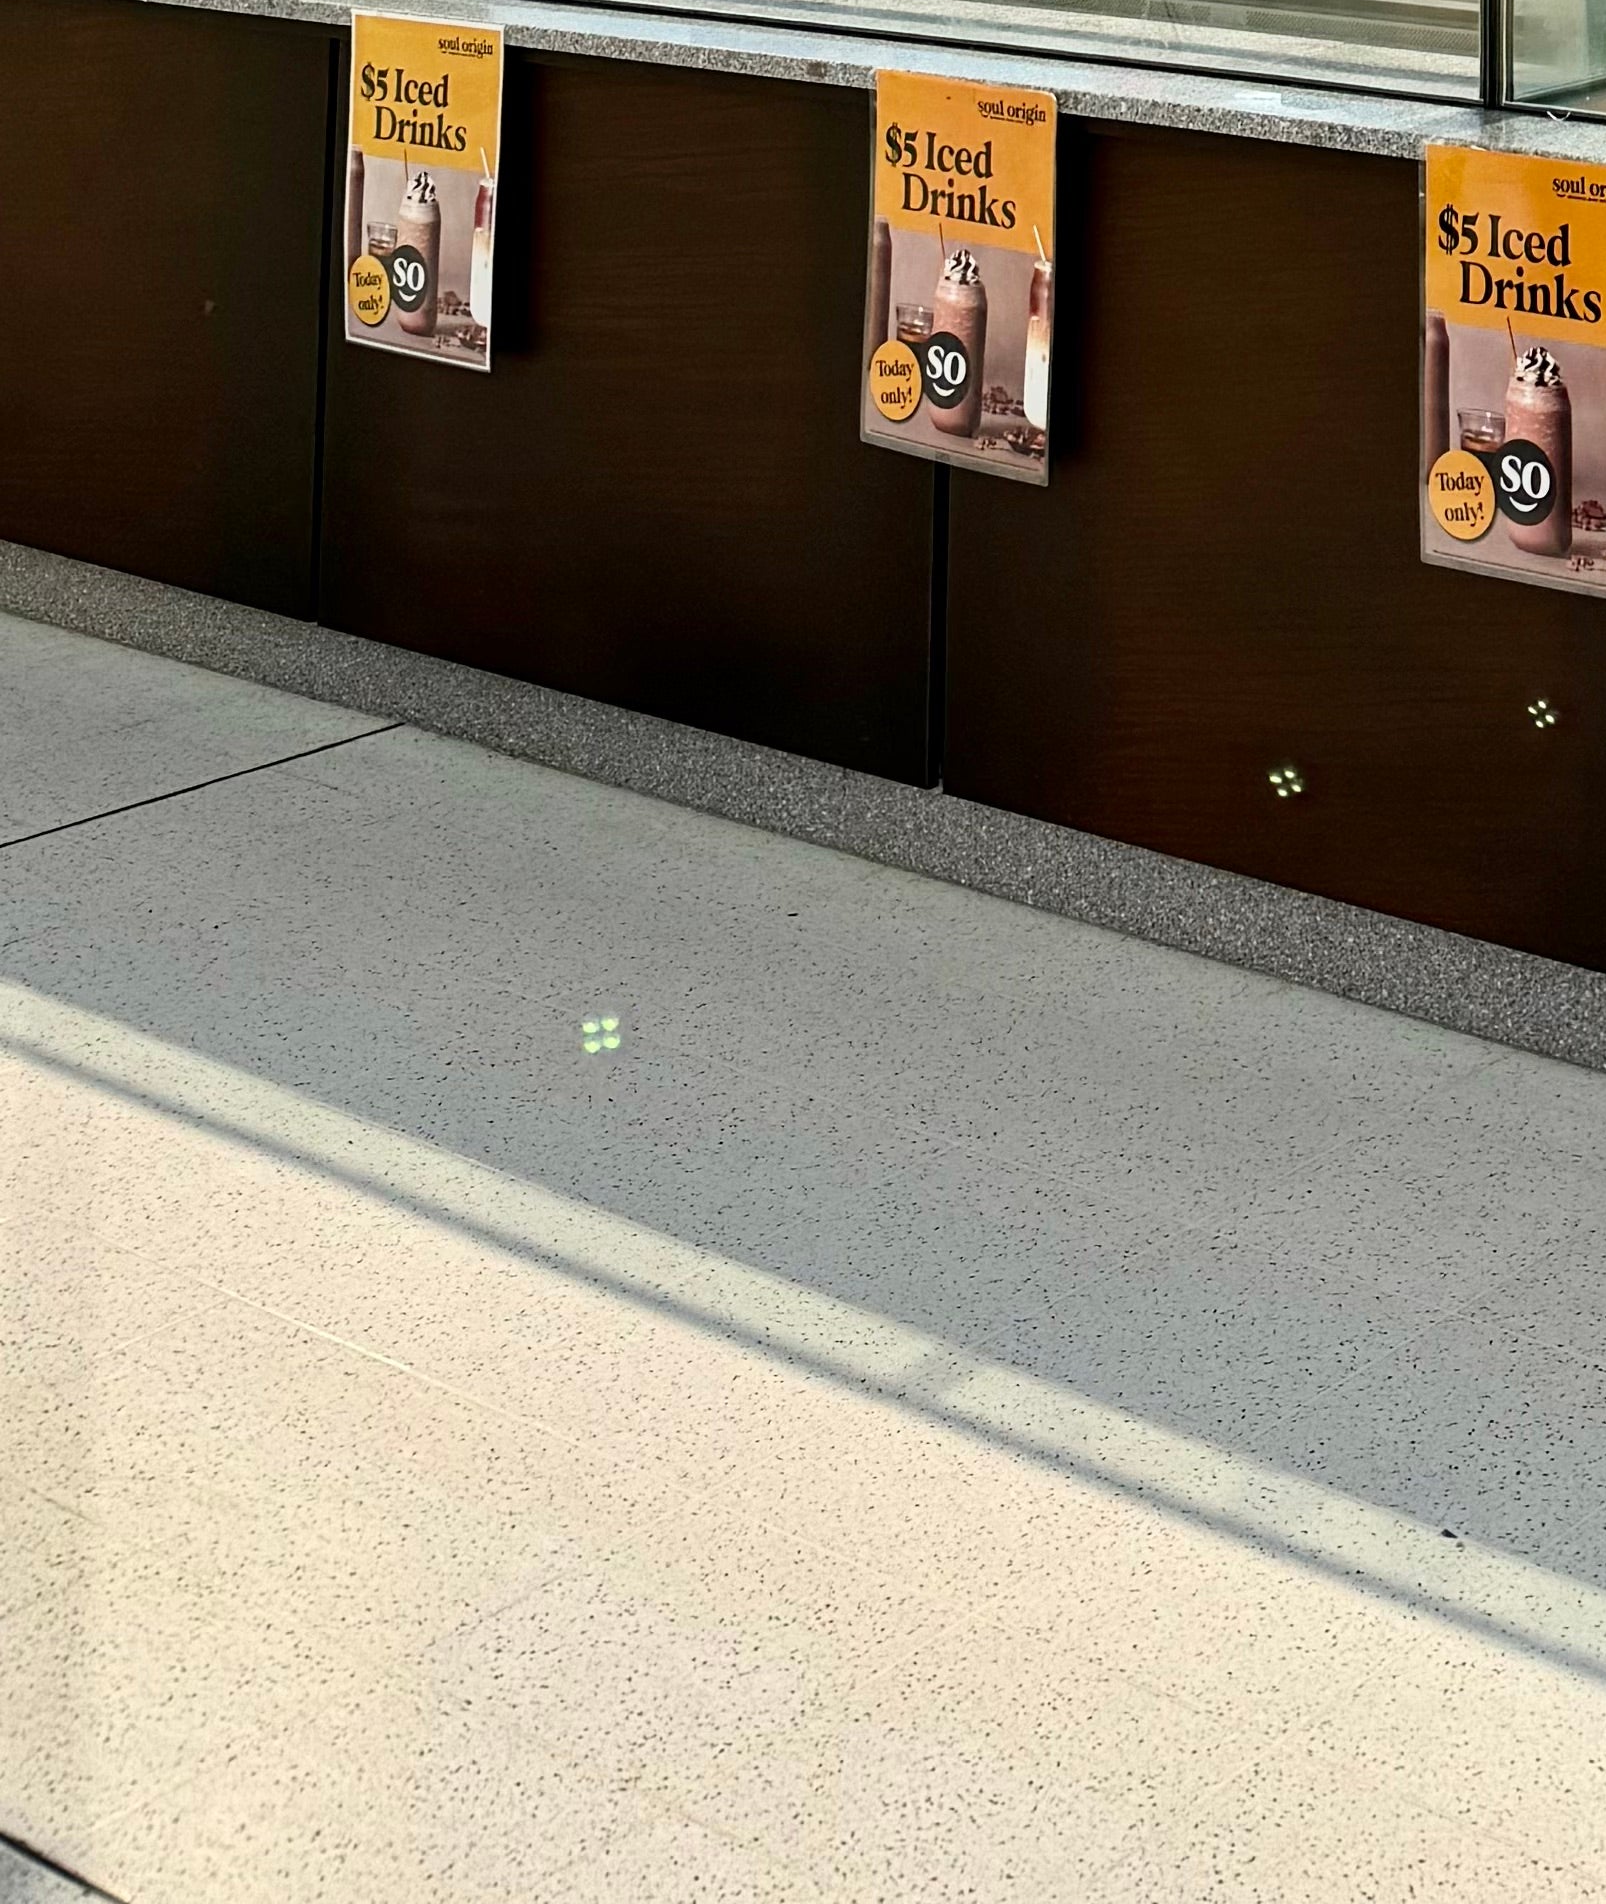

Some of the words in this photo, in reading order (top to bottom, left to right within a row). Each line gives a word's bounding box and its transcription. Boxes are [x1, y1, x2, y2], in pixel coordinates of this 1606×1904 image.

[438, 36, 460, 54] soul
[462, 38, 493, 60] origin
[361, 62, 389, 101] $5
[395, 68, 449, 108] Iced
[977, 99, 1004, 117] soul
[1007, 103, 1046, 126] origin
[373, 105, 467, 152] Drinks
[885, 122, 918, 168] $5
[925, 131, 993, 178] Iced
[902, 172, 1016, 230] Drinks
[1552, 175, 1585, 196] soul
[1438, 204, 1479, 256] $5
[1489, 214, 1572, 268] Iced
[353, 272, 383, 290] Today
[393, 257, 425, 292] SO
[358, 294, 385, 313] only!
[1460, 260, 1601, 323] Drinks
[876, 359, 914, 379] Today
[926, 345, 967, 385] SO
[881, 385, 913, 407] only!
[1436, 471, 1484, 495] Today
[1500, 454, 1551, 499] SO
[1444, 501, 1485, 526] only!
